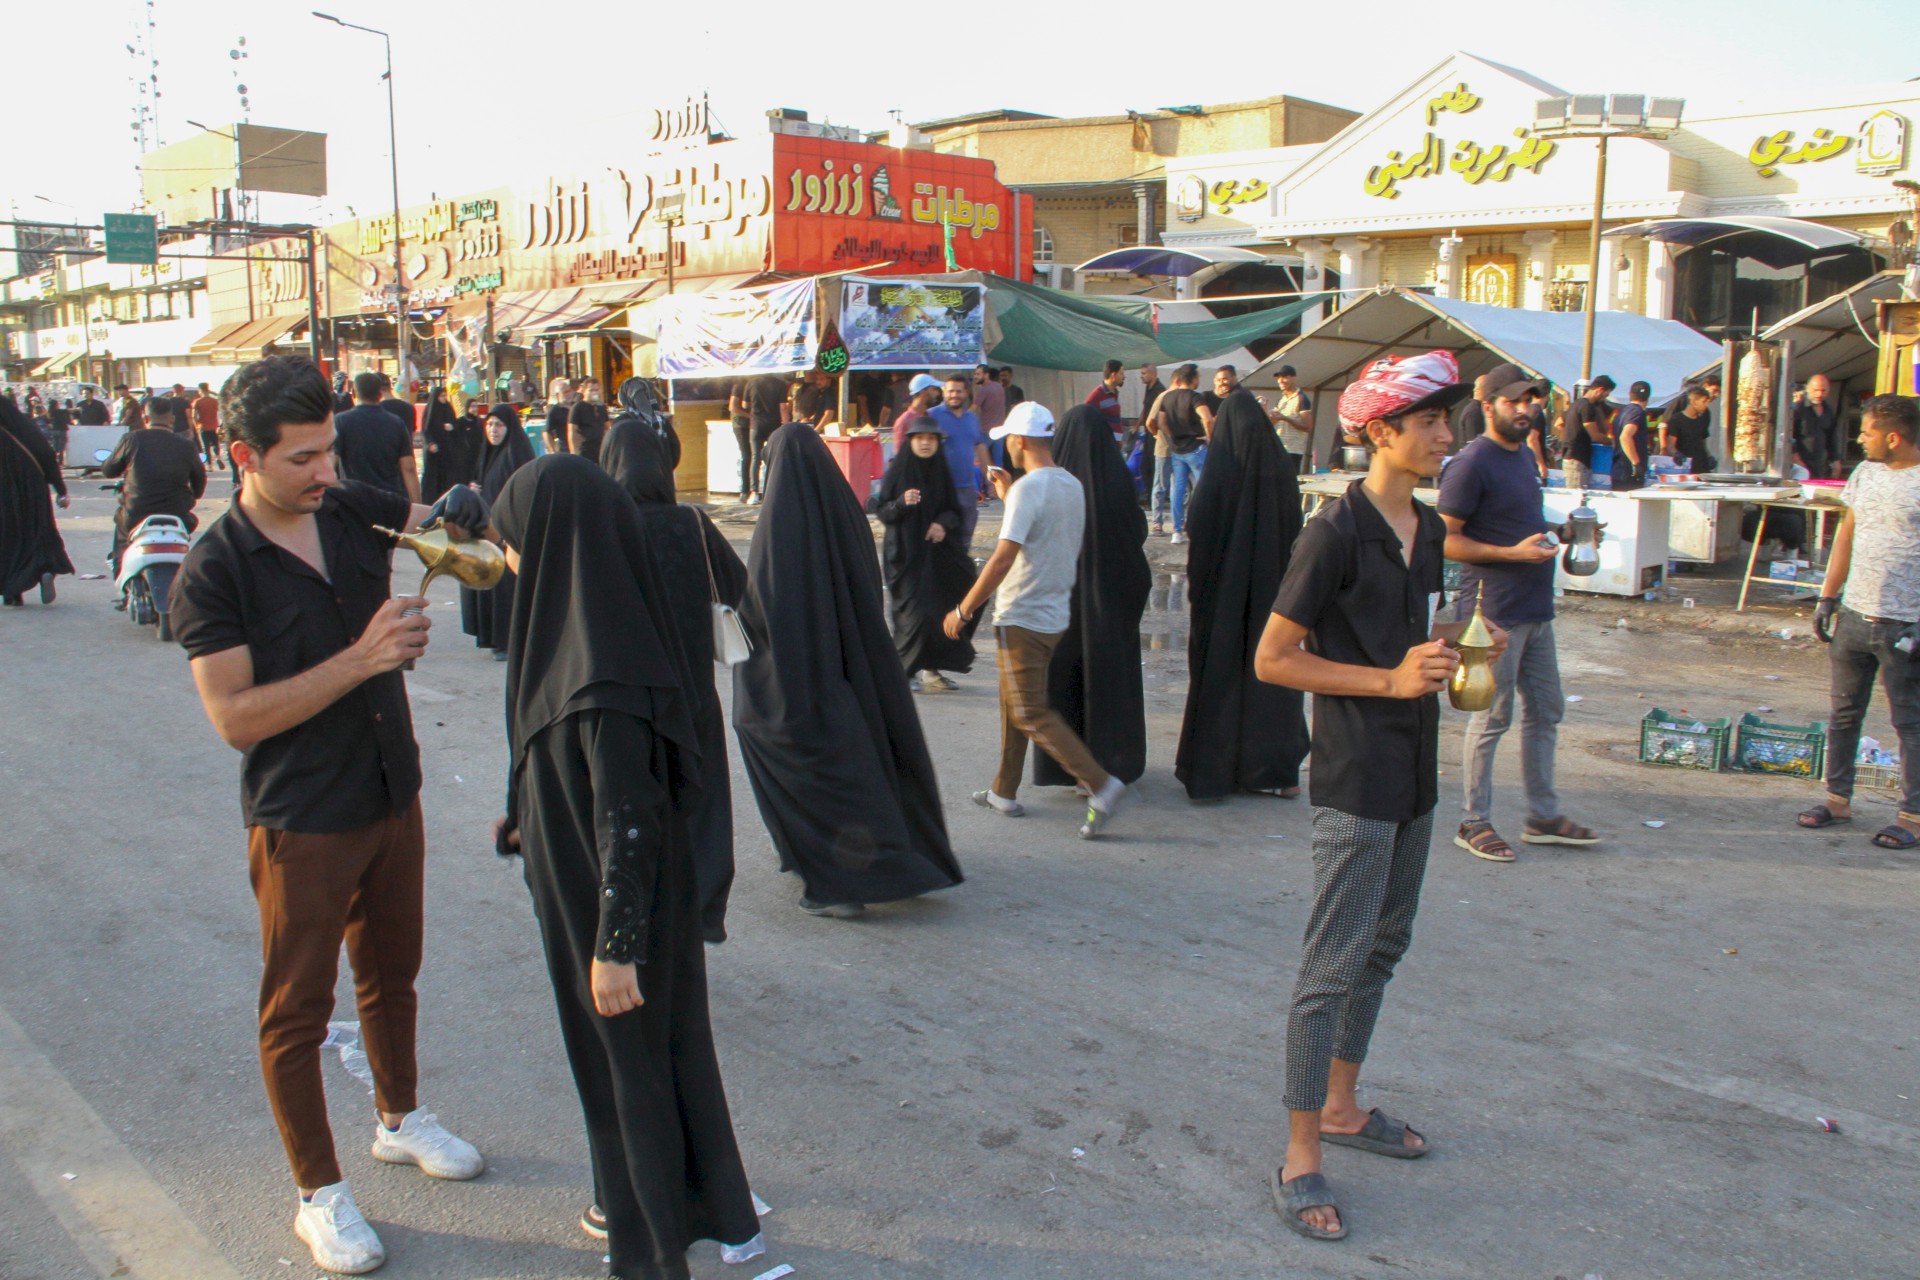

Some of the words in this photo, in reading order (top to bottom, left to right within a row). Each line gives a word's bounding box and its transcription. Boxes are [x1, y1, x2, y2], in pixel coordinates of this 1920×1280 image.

[1425, 83, 1483, 126] مطعم
[1364, 131, 1445, 200] اليمني
[1449, 126, 1558, 185] حضرموت
[1749, 127, 1855, 178] مندي
[786, 160, 863, 216] زرزور
[912, 182, 999, 238] مرطبات
[1208, 178, 1270, 214] مندي
